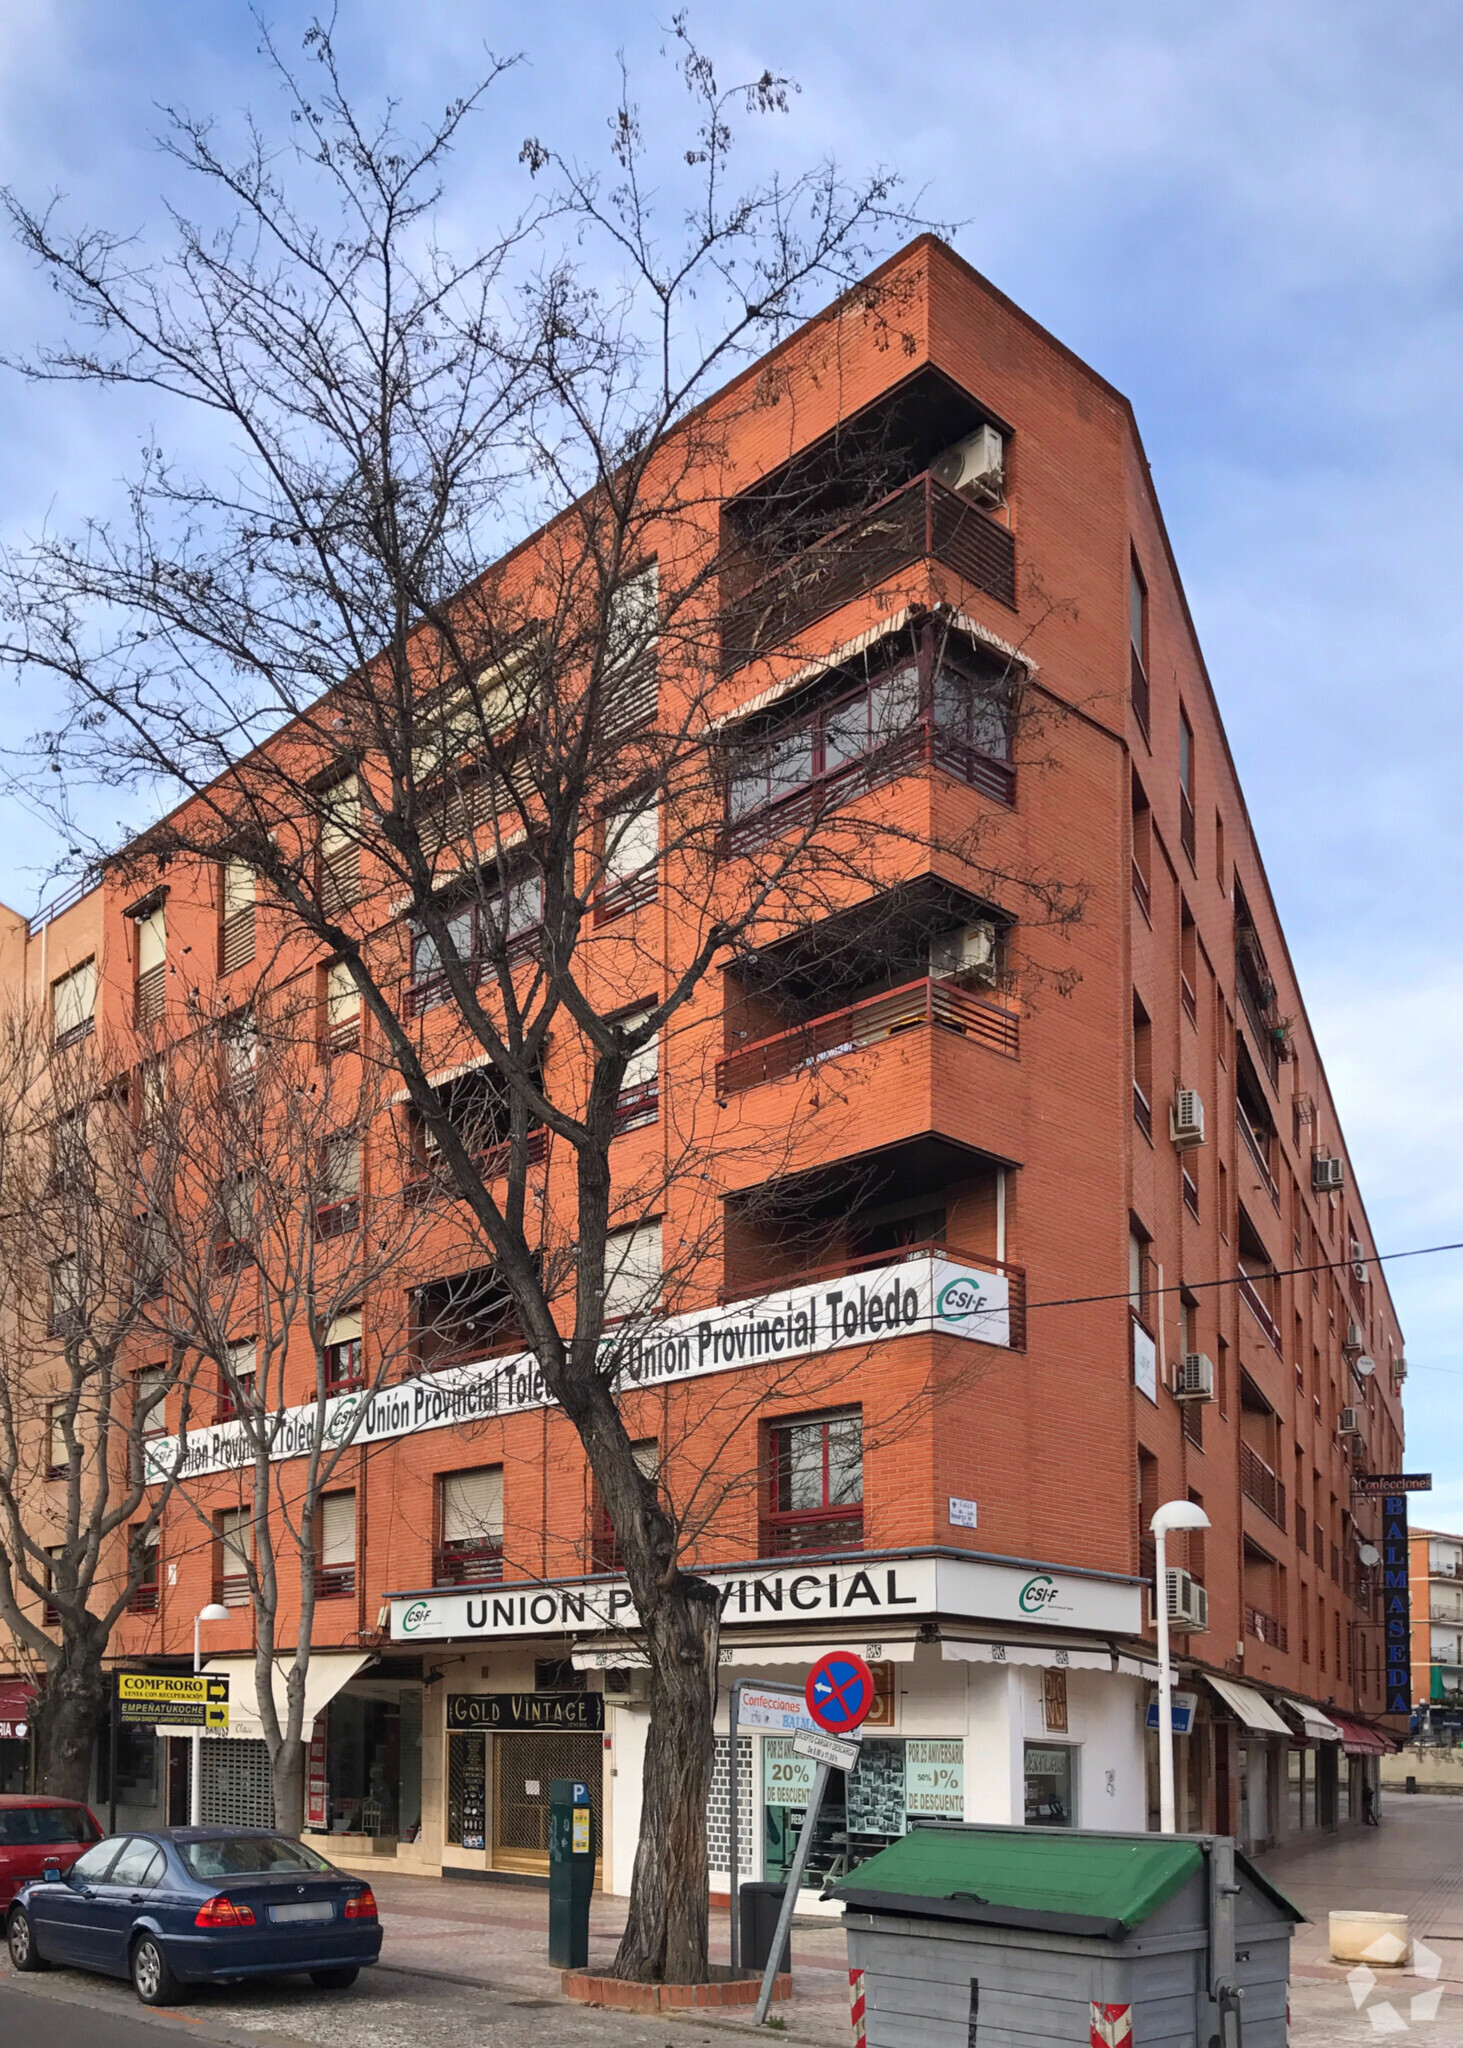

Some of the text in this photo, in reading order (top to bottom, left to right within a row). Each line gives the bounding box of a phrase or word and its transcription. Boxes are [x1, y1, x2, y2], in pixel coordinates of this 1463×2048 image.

[629, 1278, 919, 1381] Unión Provincial Toledo
[366, 1392, 409, 1435] Unión
[415, 1368, 499, 1424] Provincial
[505, 1360, 554, 1406] Tole
[280, 1412, 315, 1452] Toled
[1358, 1477, 1431, 1491] Confecciones
[466, 1569, 917, 1629] UNION PVINCIAL
[1384, 1497, 1409, 1712] BALMASEDA
[124, 1678, 203, 1692] COMPRORO
[121, 1702, 204, 1714] EMPEÑATUKOCHE
[455, 1695, 588, 1721] GOLD VINTAGE
[742, 1693, 801, 1713] Confecciones
[767, 1740, 776, 1760] POR
[795, 1731, 815, 1744] EXCEPTO
[815, 1736, 829, 1748] CARGA
[832, 1743, 855, 1757] DESCARGA
[908, 1743, 919, 1764] POR
[920, 1743, 927, 1764] 25
[772, 1763, 809, 1783] 20%
[917, 1773, 932, 1782] 50%
[573, 1783, 585, 1802] P
[767, 1786, 811, 1804] DE DESCUENT
[908, 1792, 919, 1810] DE
